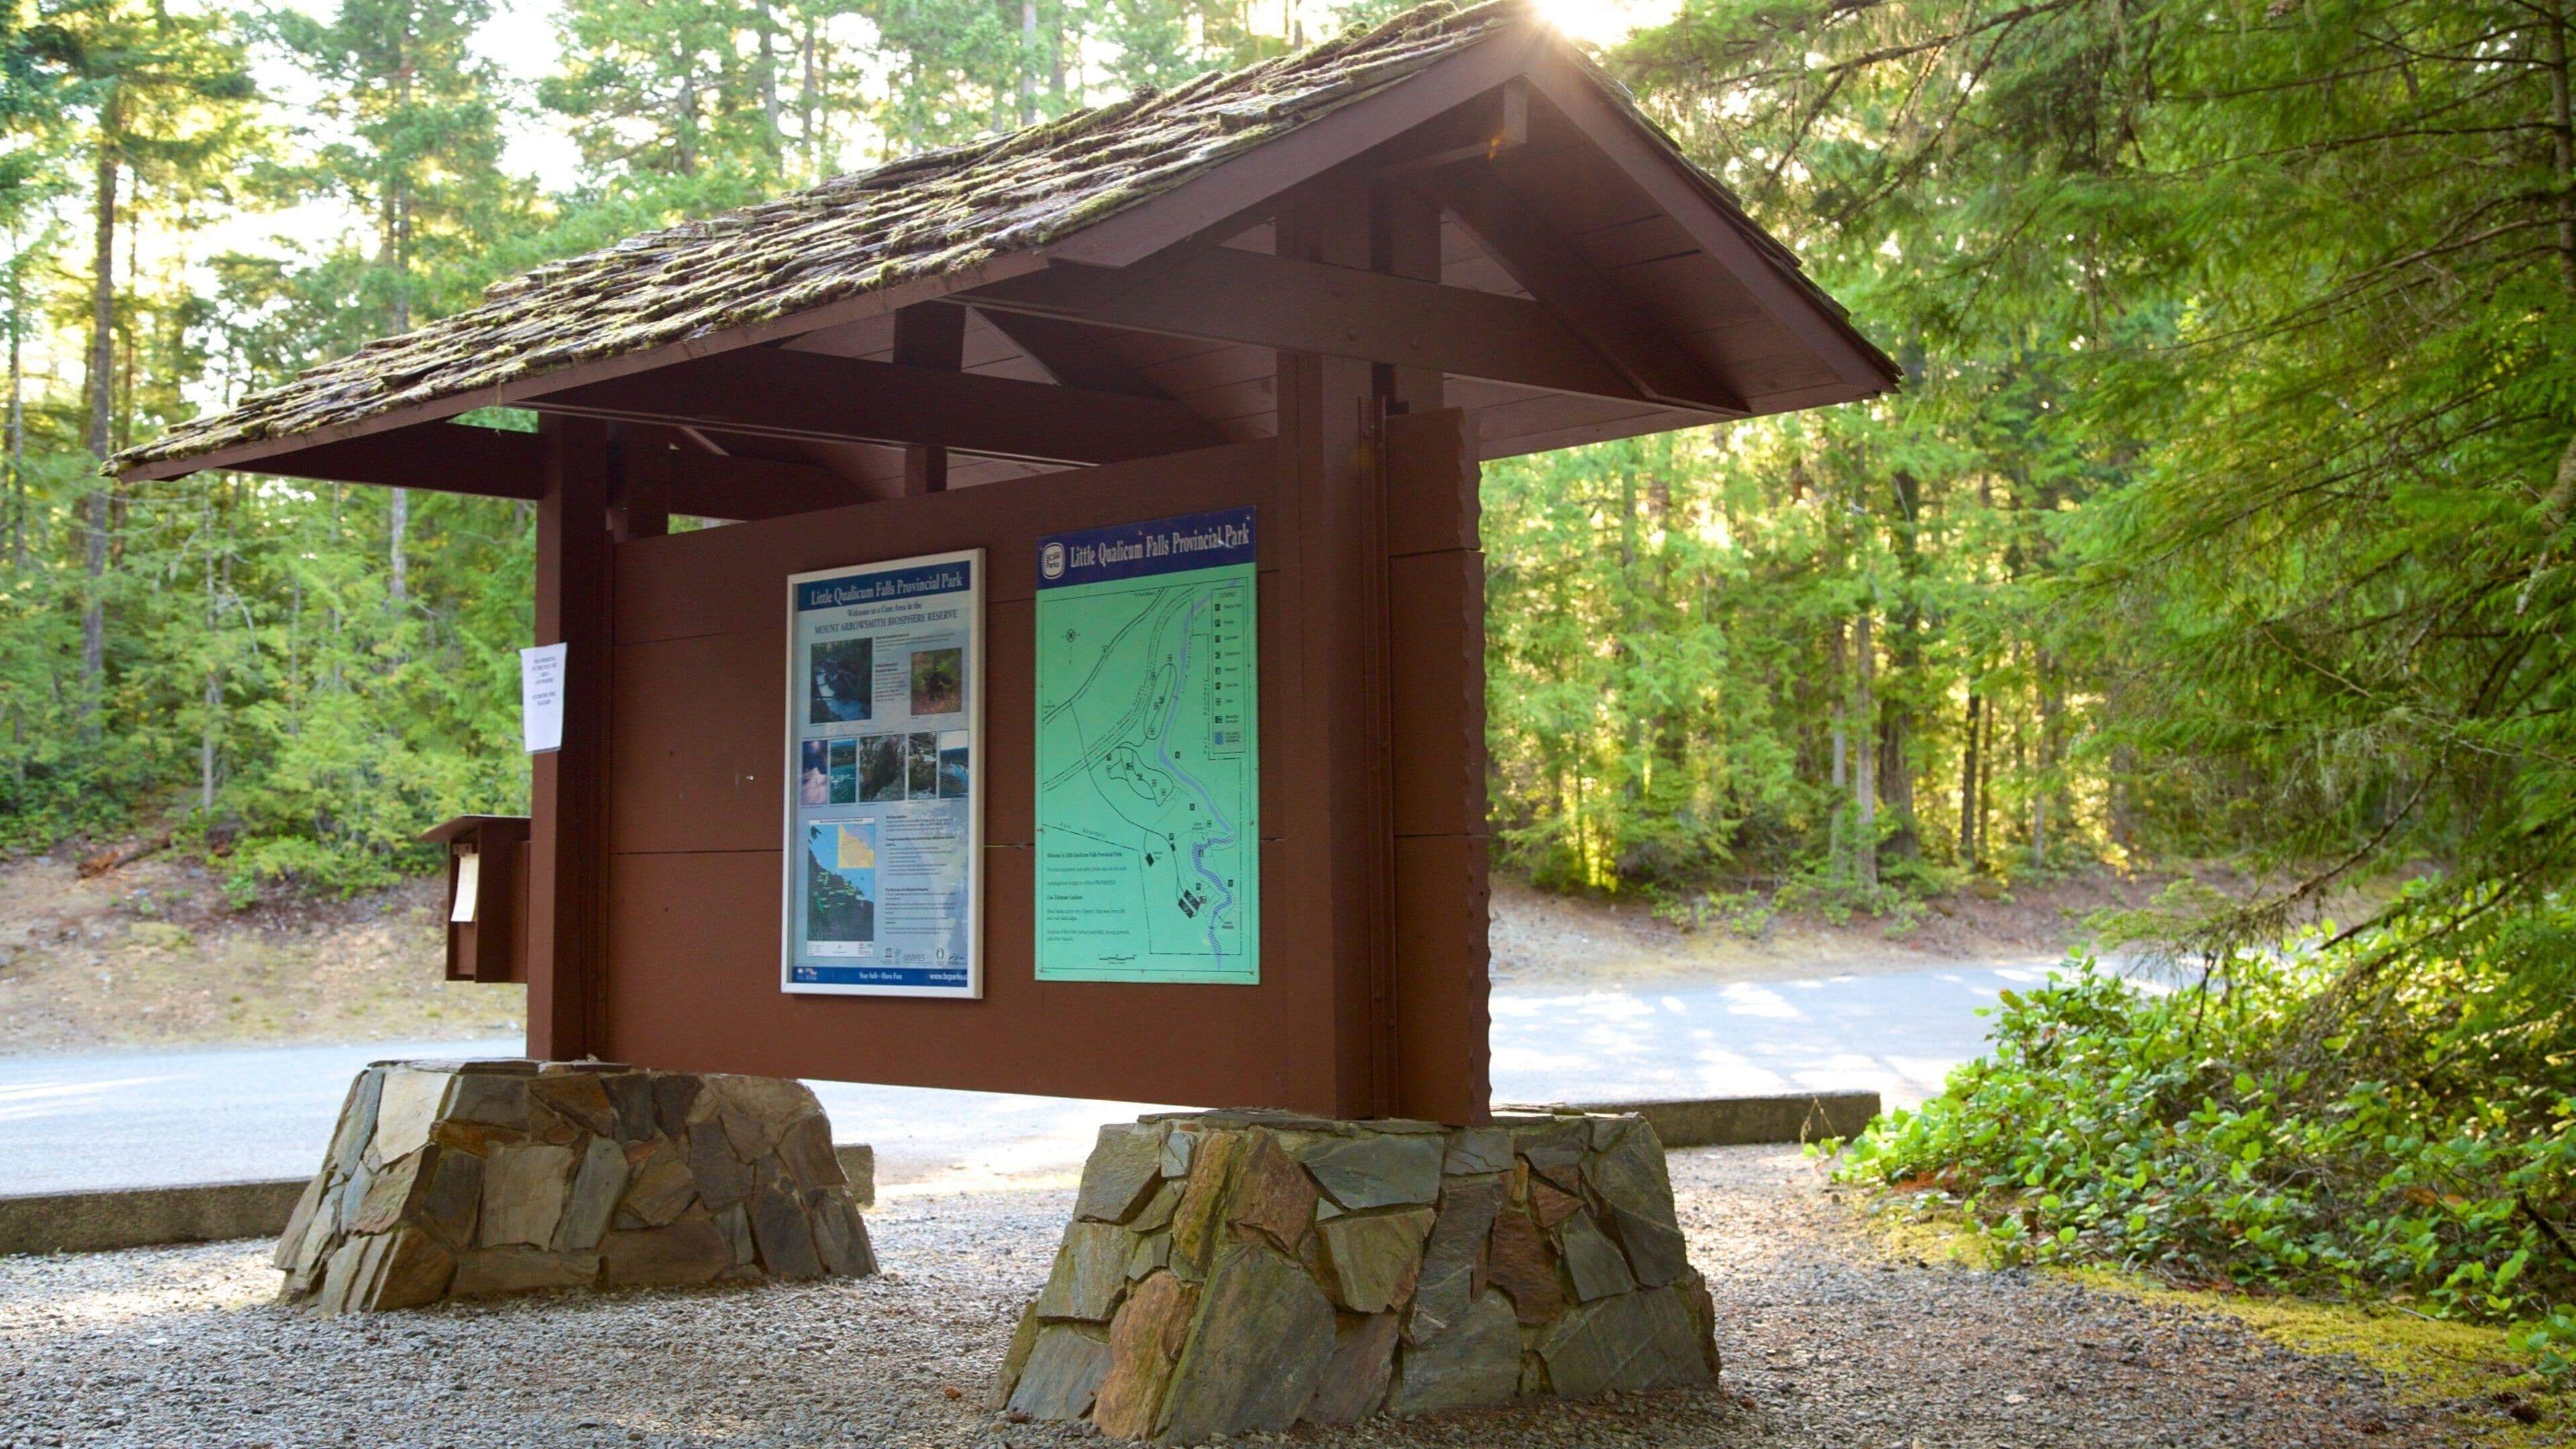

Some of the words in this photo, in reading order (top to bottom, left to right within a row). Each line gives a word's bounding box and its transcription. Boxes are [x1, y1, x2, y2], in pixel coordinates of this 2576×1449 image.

[1071, 544, 1095, 568] Little
[1098, 540, 1142, 568] Qualicum
[1146, 534, 1169, 557] Falls
[1173, 526, 1221, 553] Provincial
[1225, 523, 1249, 547] Park
[810, 588, 833, 605] Little
[834, 585, 873, 605] Qualicum
[875, 580, 895, 597] Falls
[897, 574, 939, 594] Provincial
[942, 571, 963, 588] Park
[815, 623, 839, 635] MOUNT
[841, 618, 886, 631] ARROWSMITH
[888, 613, 926, 627] BIOSPHERE
[927, 609, 957, 621] RESERVE
